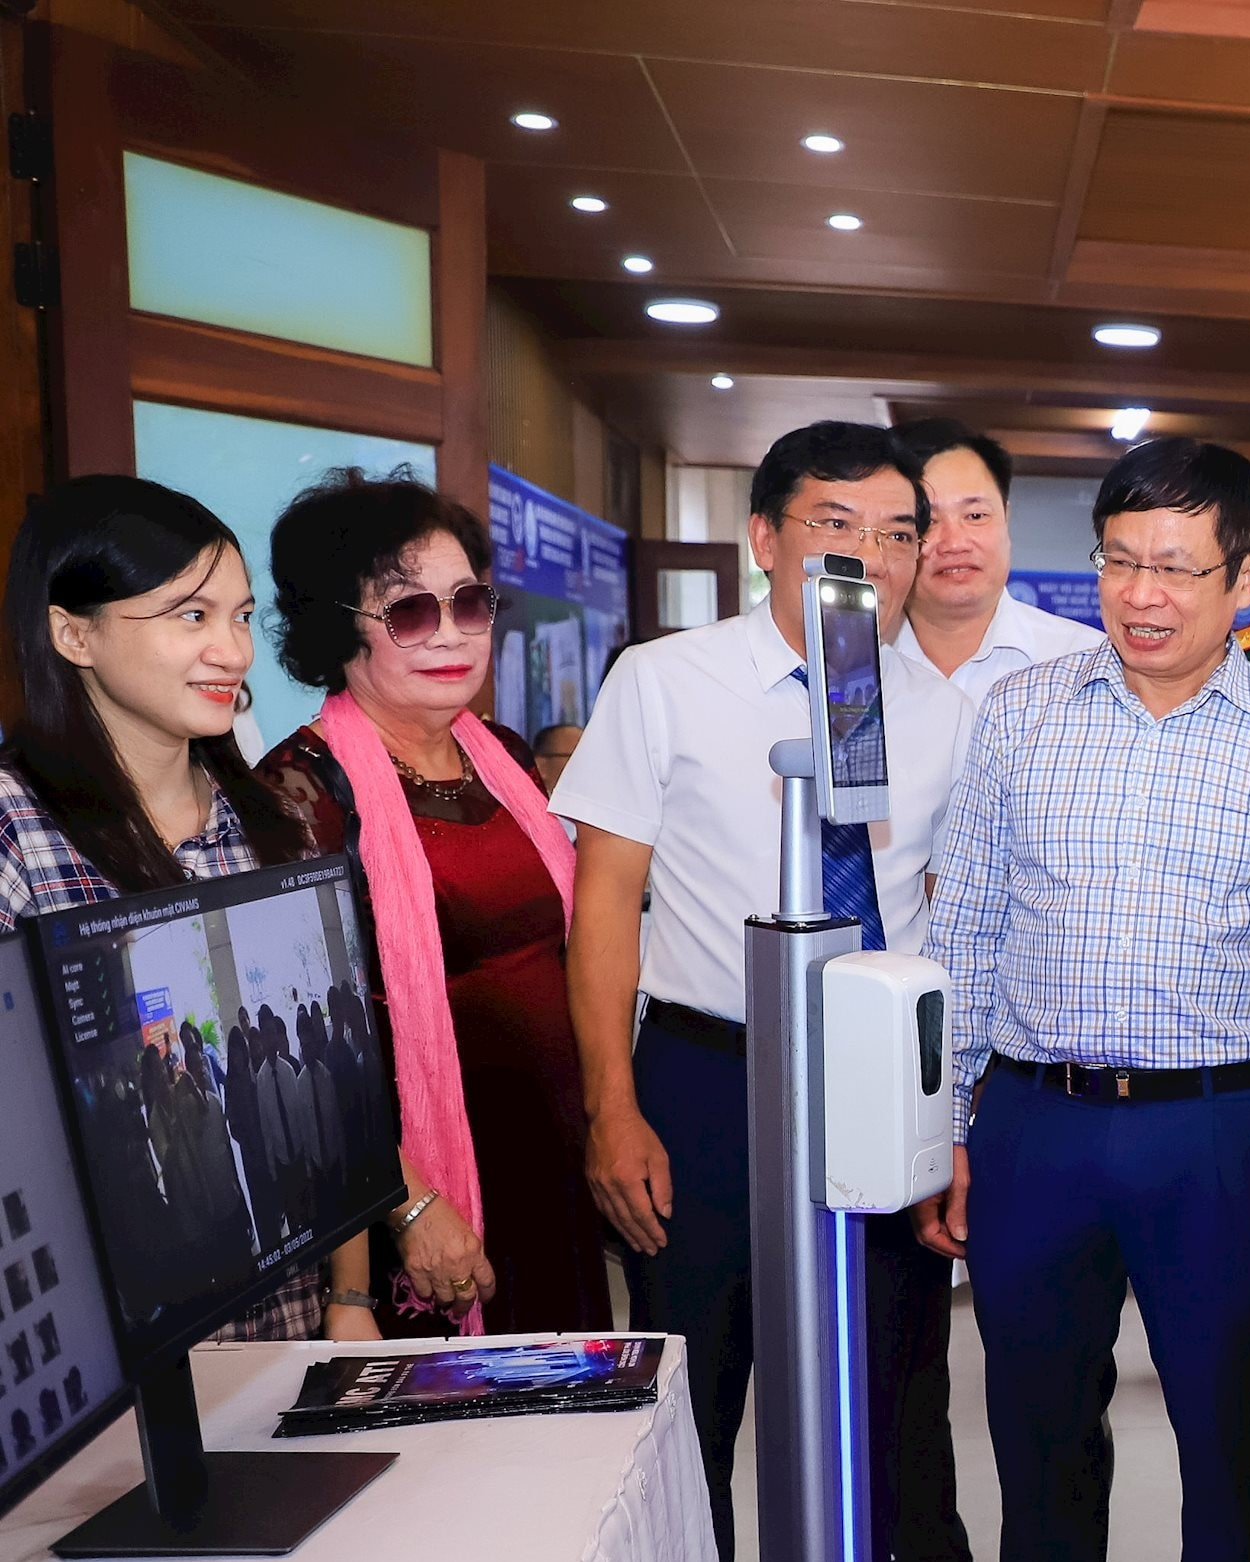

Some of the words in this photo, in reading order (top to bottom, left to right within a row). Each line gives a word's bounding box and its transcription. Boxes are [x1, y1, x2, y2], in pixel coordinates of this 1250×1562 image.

[72, 1012, 95, 1026] Camera
[75, 1029, 98, 1042] License
[355, 1361, 400, 1382] ATI
